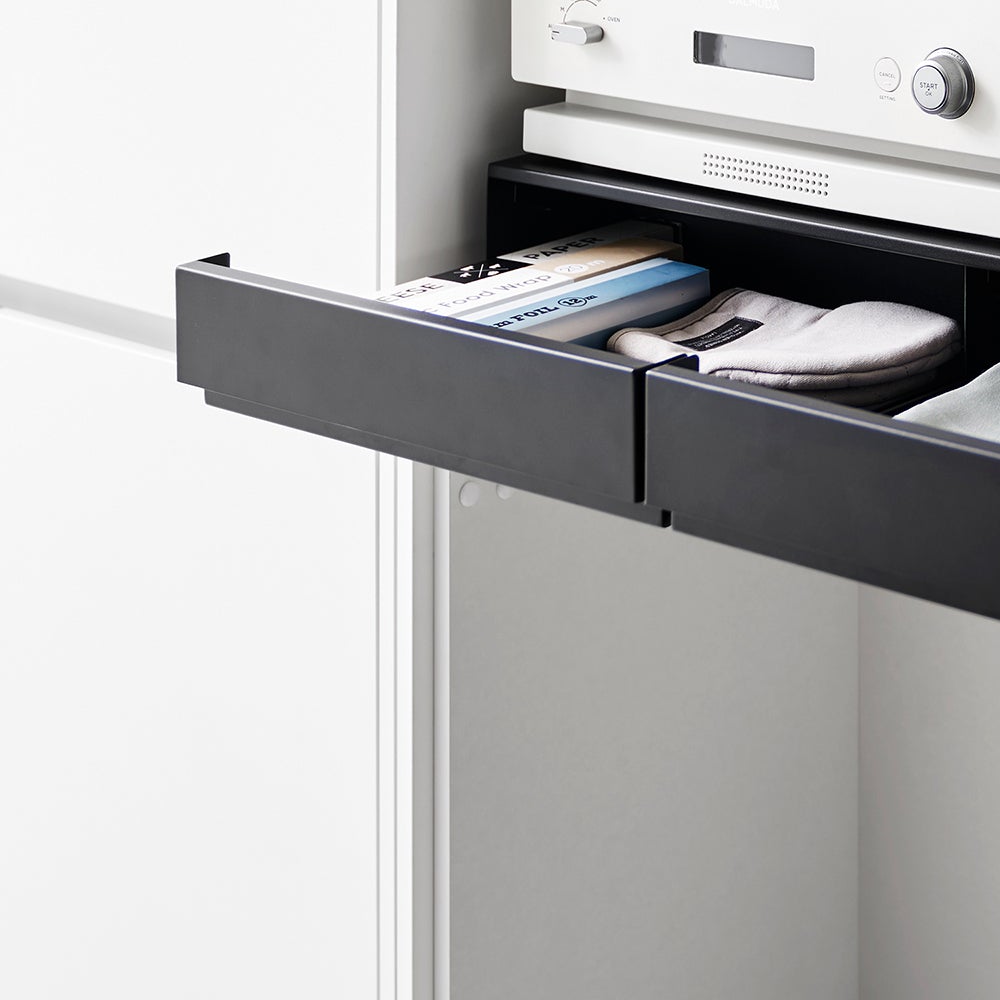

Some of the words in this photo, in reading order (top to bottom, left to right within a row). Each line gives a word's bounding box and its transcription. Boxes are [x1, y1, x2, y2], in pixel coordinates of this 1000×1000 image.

[878, 71, 896, 80] CANCEL
[919, 82, 939, 90] START
[522, 237, 605, 260] PAPER
[438, 290, 497, 308] Food
[494, 274, 552, 291] Wrap
[510, 306, 560, 322] FOIL
